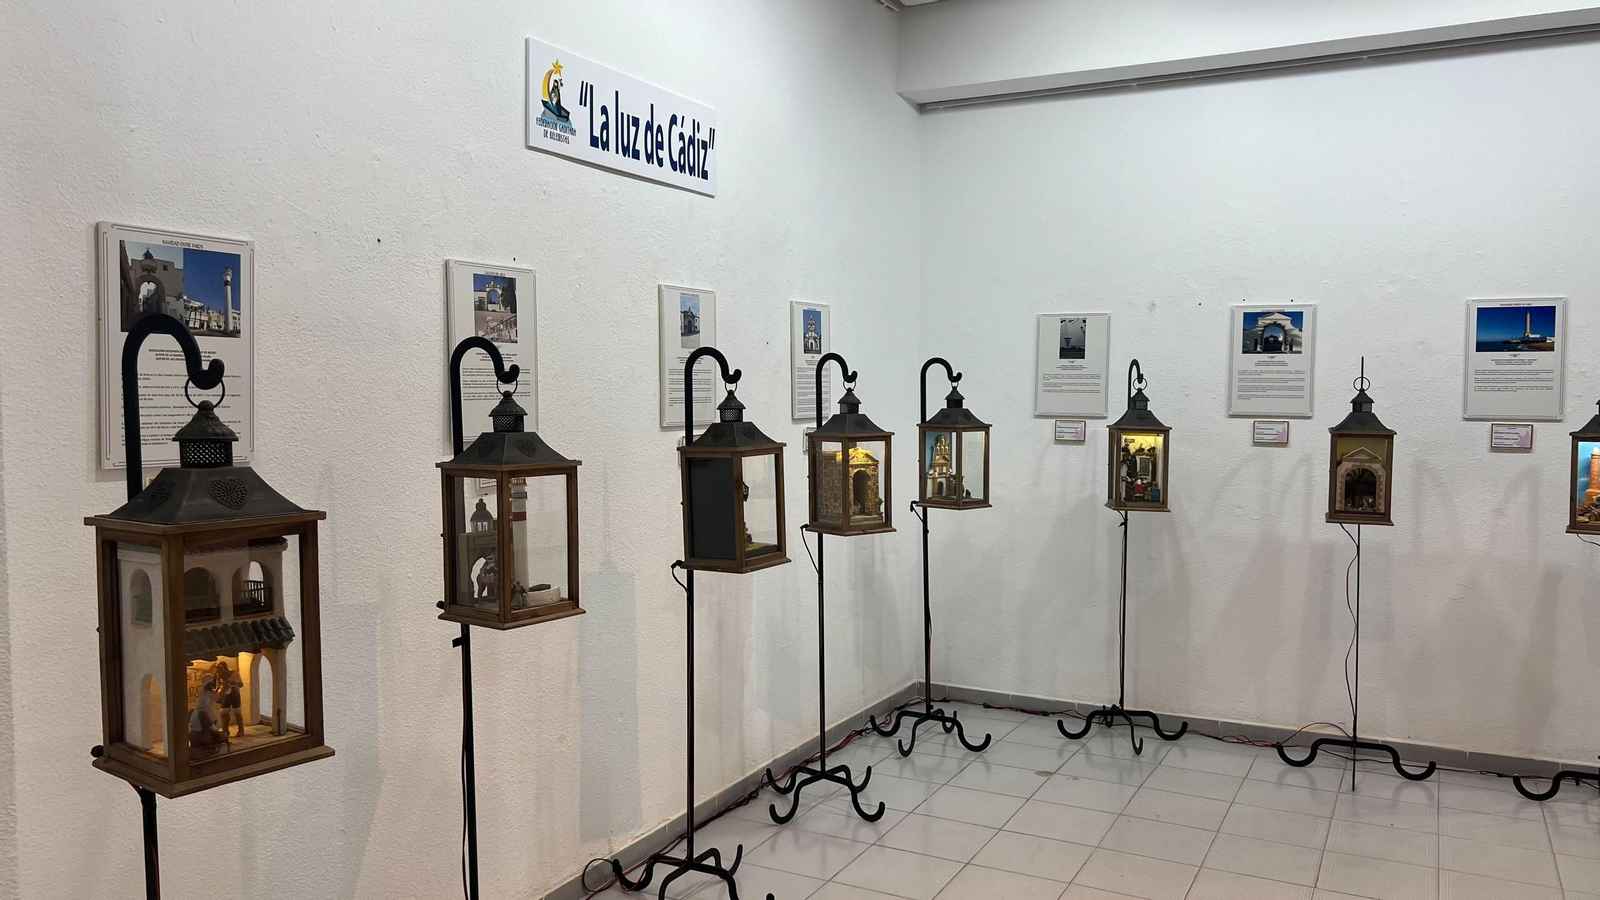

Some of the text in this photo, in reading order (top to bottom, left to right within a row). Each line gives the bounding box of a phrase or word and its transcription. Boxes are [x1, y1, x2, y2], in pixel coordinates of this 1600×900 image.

[536, 116, 577, 137] FEDERACIÓN GADITANA
[543, 129, 570, 145] DE BELENISTAS
[579, 80, 716, 181] “La luz de Cádiz”
